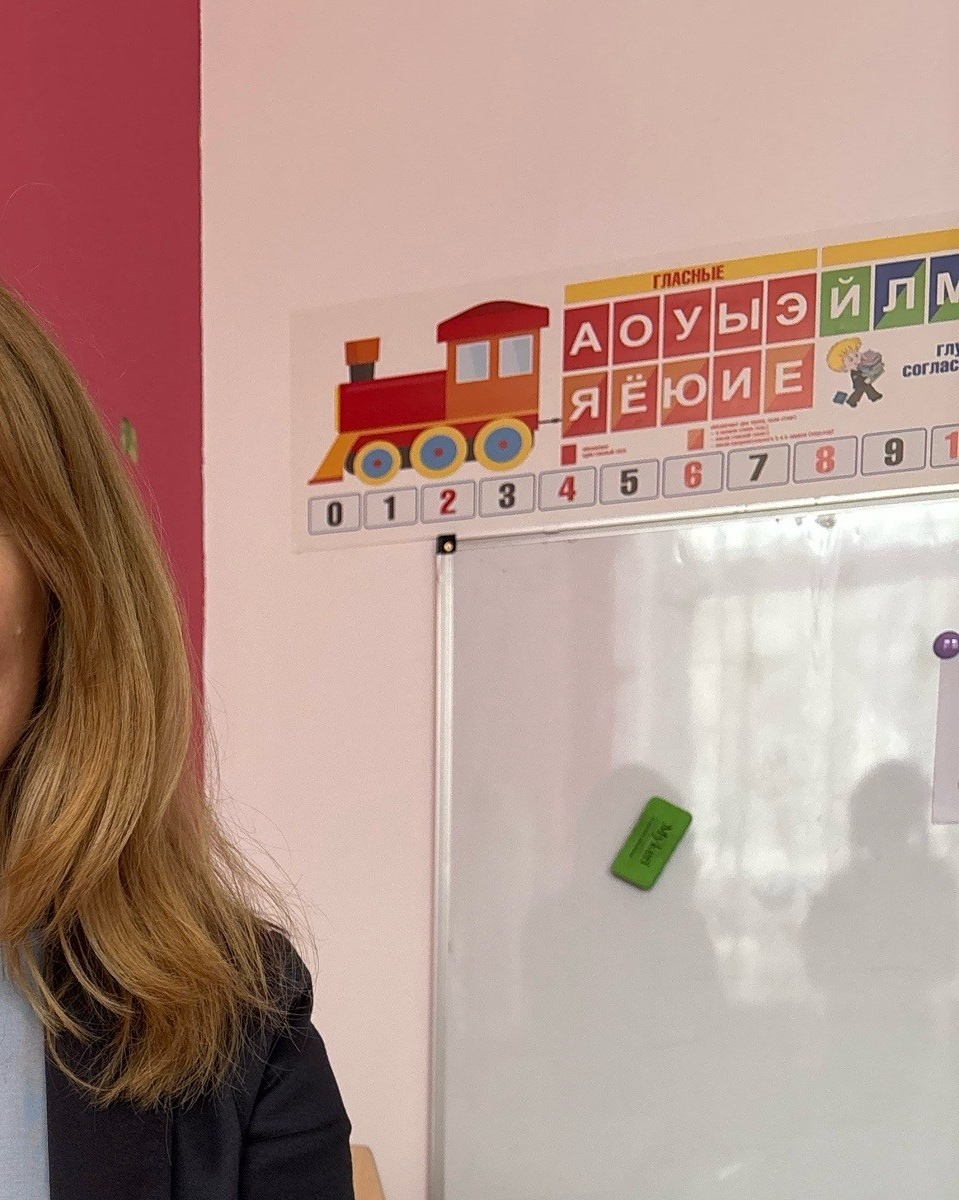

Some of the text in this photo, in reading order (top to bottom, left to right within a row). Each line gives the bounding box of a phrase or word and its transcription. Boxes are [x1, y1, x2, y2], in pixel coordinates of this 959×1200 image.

[653, 265, 724, 289] ГЛАСНЫЕ
[569, 322, 603, 356] А
[619, 314, 653, 348] О
[674, 306, 702, 341] У
[719, 298, 759, 335] Ы
[776, 292, 807, 326] Э
[831, 276, 860, 320] Й
[883, 276, 915, 312] Л
[569, 360, 802, 422] Я Ё Ю И Е
[327, 501, 341, 527] 0
[384, 496, 395, 520] 1
[440, 489, 456, 515] 2
[499, 483, 515, 509] 3
[558, 475, 576, 501] 4
[620, 469, 638, 496] 5
[684, 460, 702, 488] 6
[749, 454, 768, 481] 7
[815, 445, 835, 474] 8
[884, 437, 904, 466] 9
